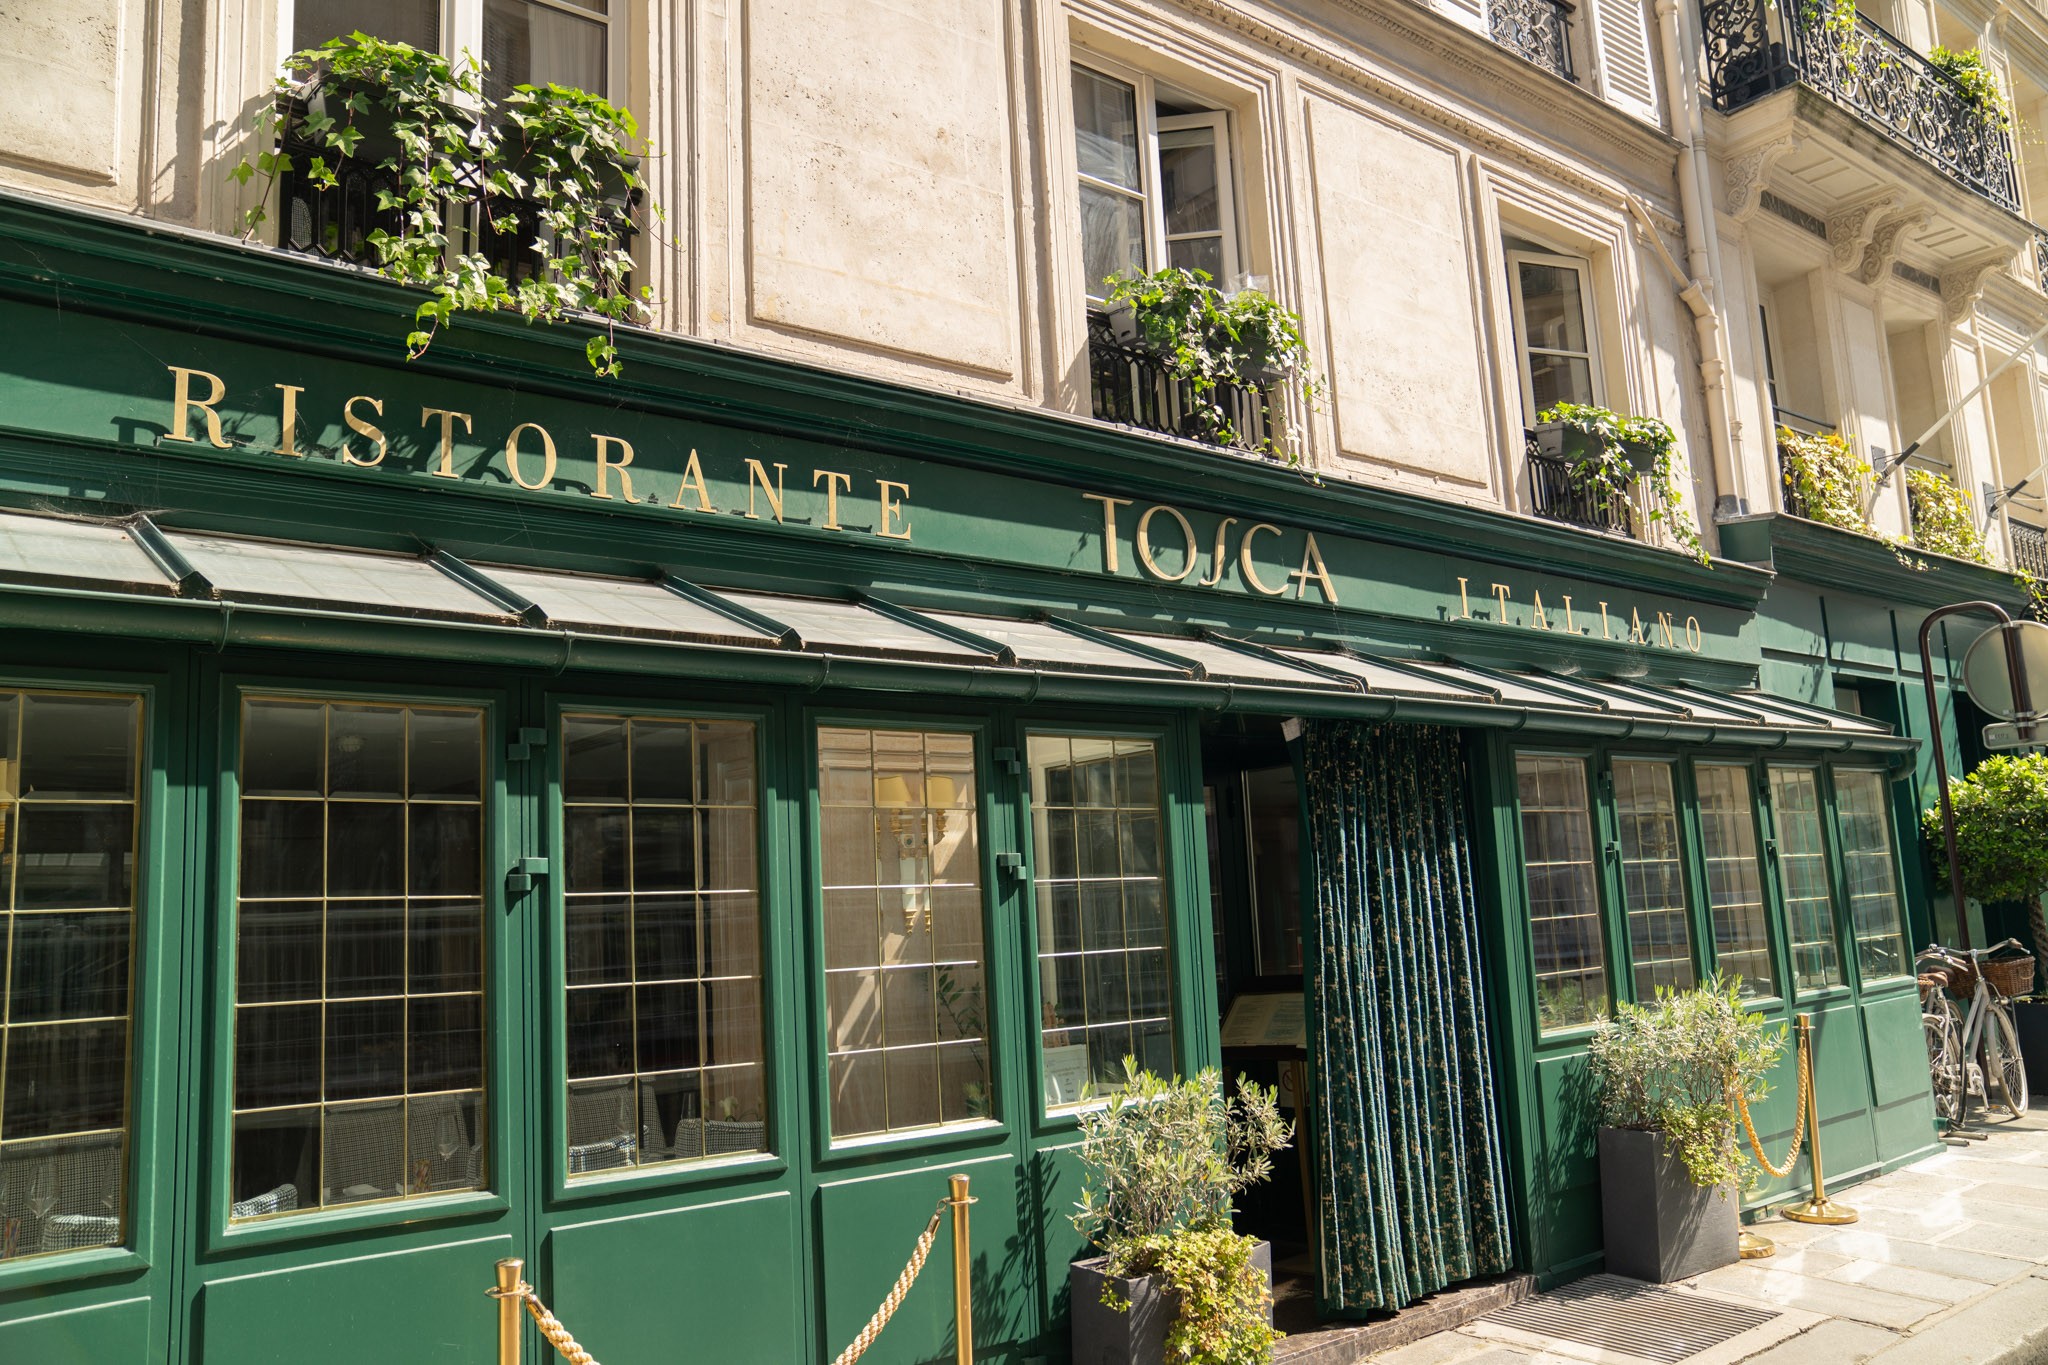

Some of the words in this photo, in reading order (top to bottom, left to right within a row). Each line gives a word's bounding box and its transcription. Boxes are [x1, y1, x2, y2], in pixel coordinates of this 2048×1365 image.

[164, 366, 912, 540] RISTORANTE
[1082, 493, 1338, 603] TOSCA
[1456, 577, 1702, 653] ITALIANO
